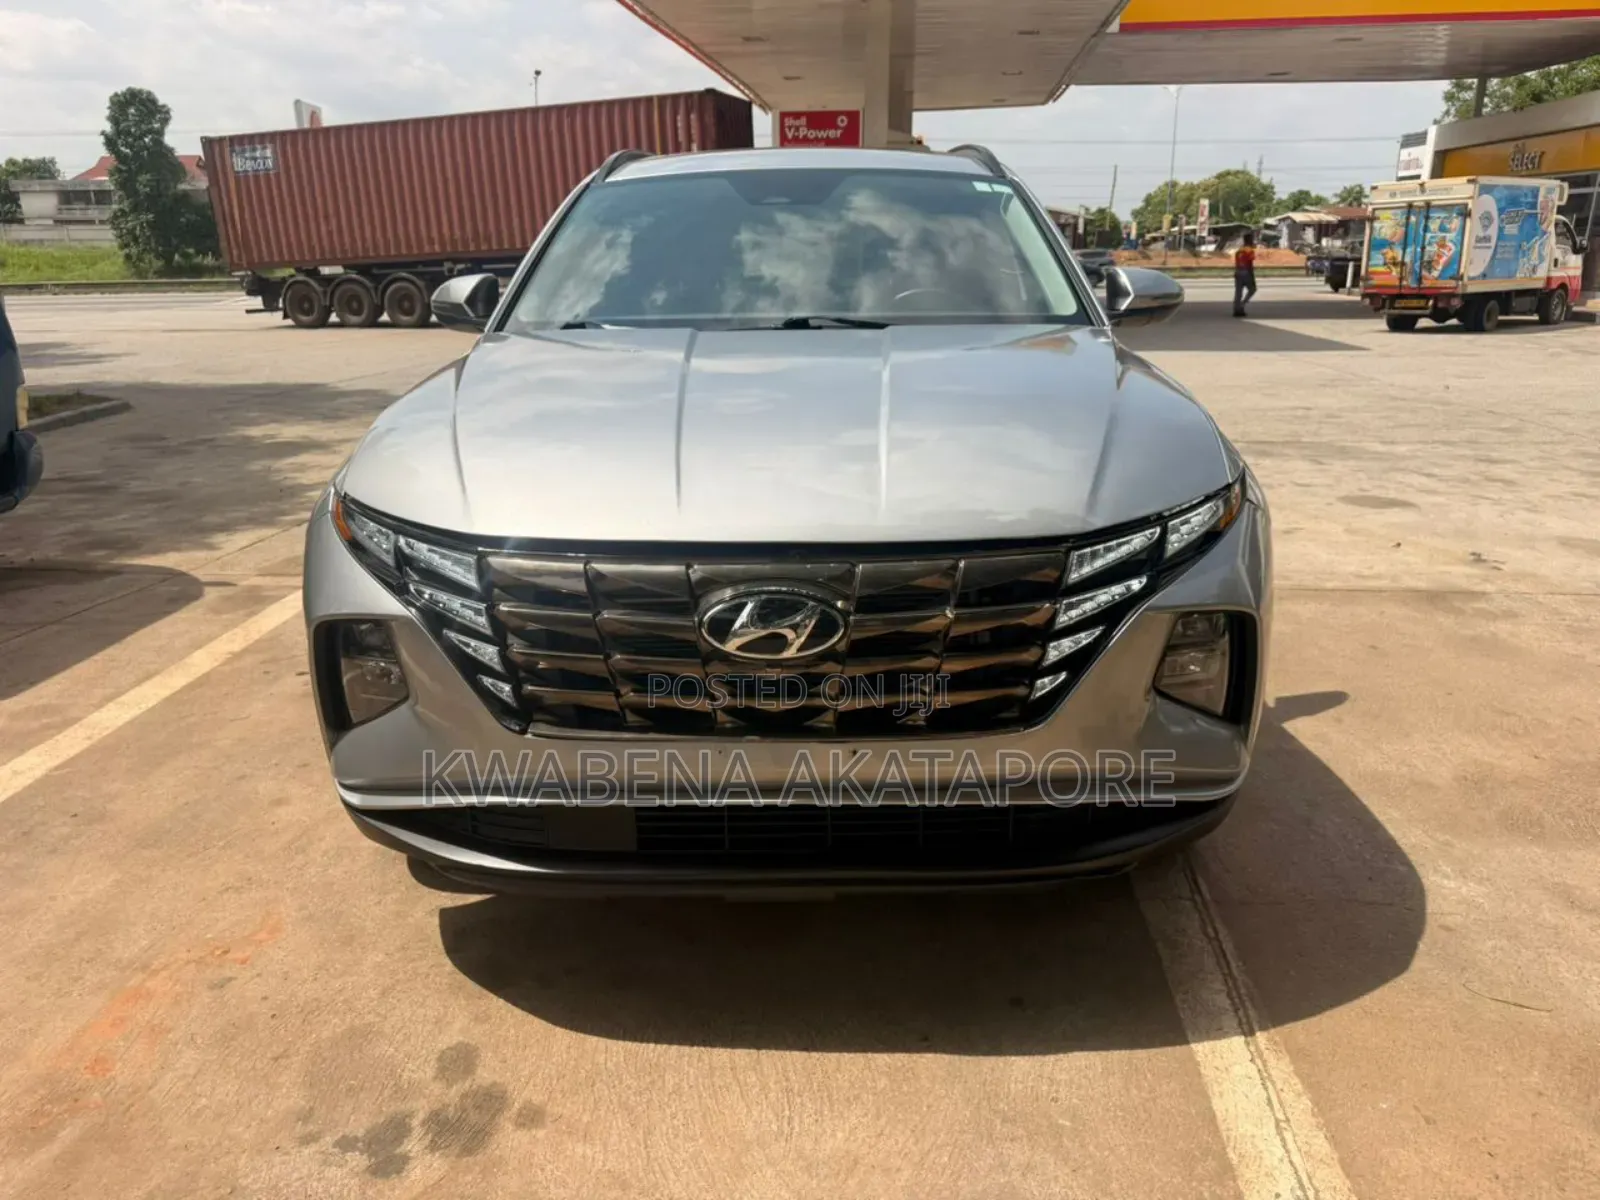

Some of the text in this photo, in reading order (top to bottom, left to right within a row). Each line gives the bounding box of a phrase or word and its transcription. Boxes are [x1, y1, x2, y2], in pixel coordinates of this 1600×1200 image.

[784, 115, 807, 126] Shell
[784, 127, 843, 140] V-Power
[1508, 149, 1546, 171] SELECT
